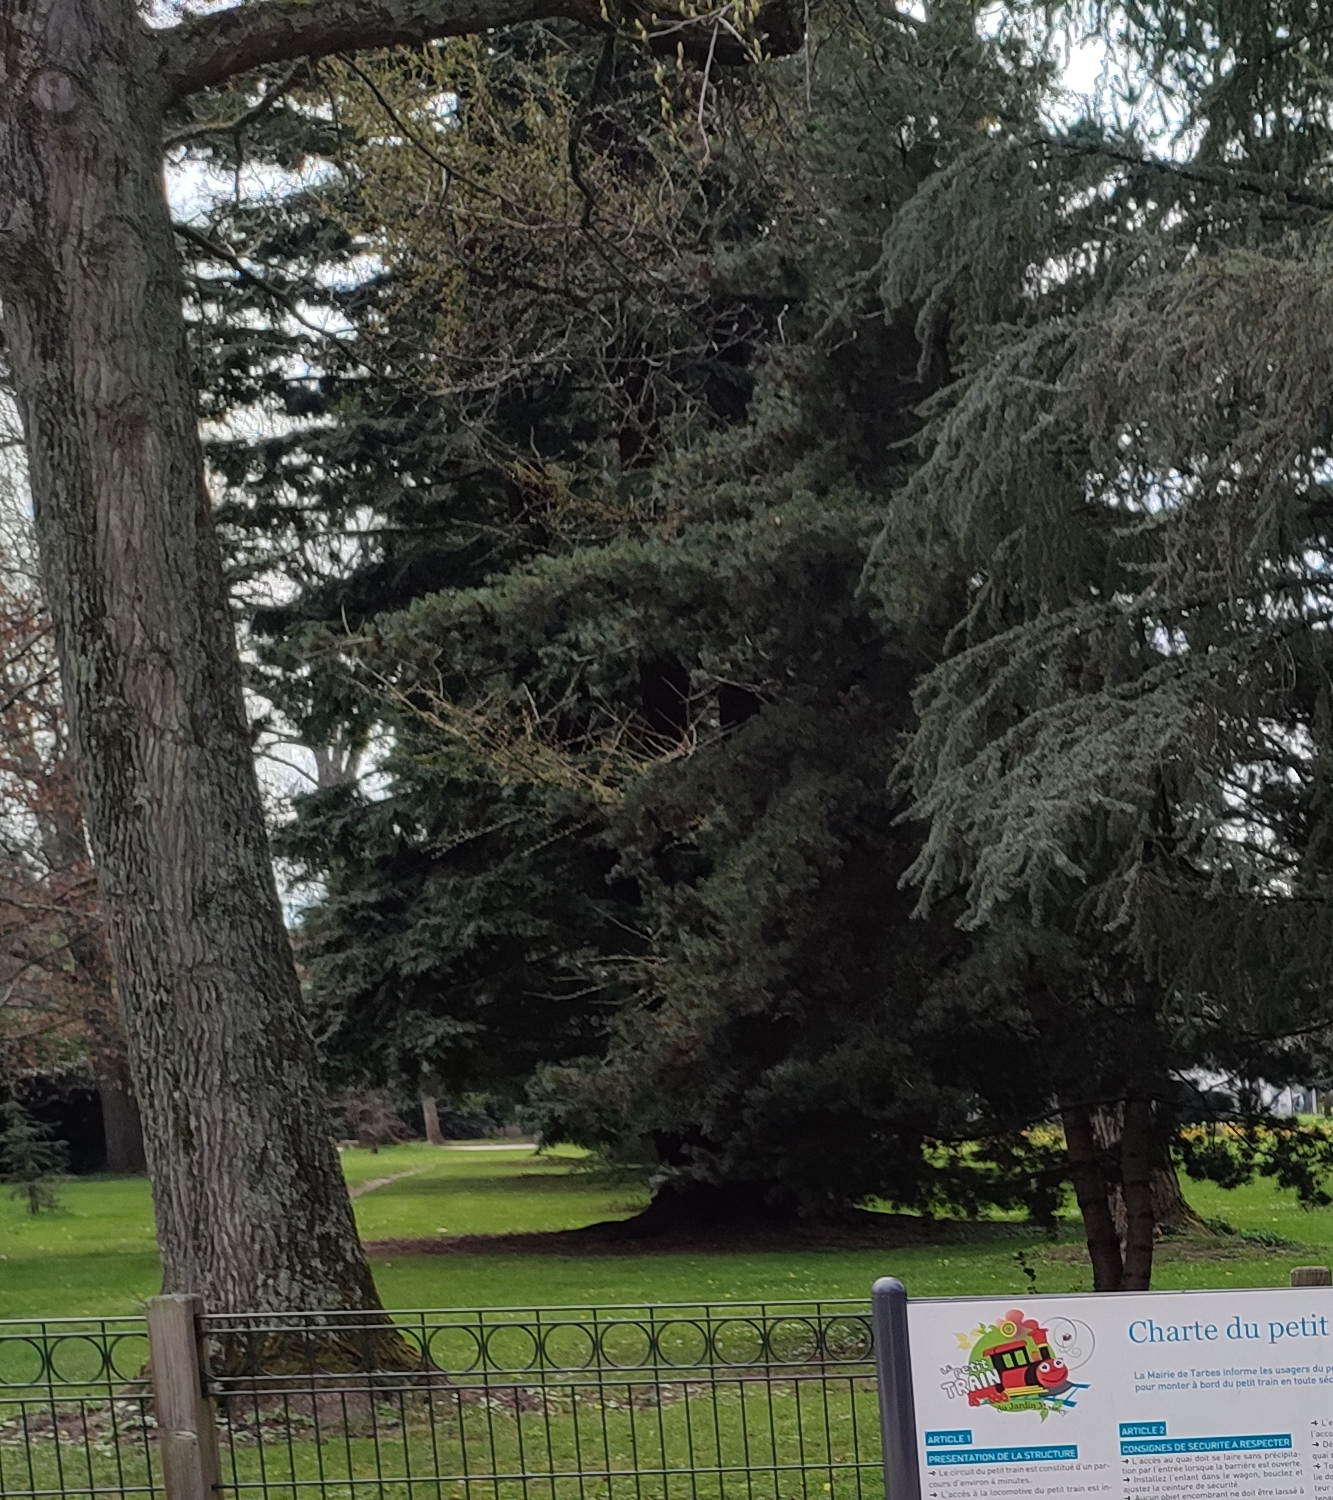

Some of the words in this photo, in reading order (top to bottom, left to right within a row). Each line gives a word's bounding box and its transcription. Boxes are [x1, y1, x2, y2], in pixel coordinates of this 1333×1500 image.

[1128, 1318, 1218, 1343] Charte
[1226, 1316, 1260, 1340] du
[1268, 1313, 1330, 1344] petit
[954, 1359, 989, 1380] petit
[1134, 1369, 1145, 1380] La
[1147, 1368, 1175, 1379] Mairie
[1177, 1368, 1188, 1378] de
[1189, 1366, 1221, 1378] Tarbes
[1222, 1365, 1258, 1376] informe
[1259, 1364, 1273, 1375] les
[1274, 1365, 1311, 1377] usagers
[1312, 1362, 1324, 1373] du
[941, 1369, 1001, 1399] TRAIN
[1135, 1383, 1156, 1394] pour
[1157, 1379, 1190, 1390] monter
[1191, 1379, 1198, 1389] à
[1199, 1378, 1220, 1389] bord
[1221, 1377, 1234, 1388] du
[1235, 1376, 1255, 1390] petit
[1257, 1375, 1279, 1386] train
[1280, 1377, 1292, 1385] en
[1293, 1374, 1316, 1385] toute
[1009, 1402, 1036, 1411] Jardin
[928, 1434, 964, 1443] ARTICLE
[965, 1434, 971, 1442] 1
[1121, 1426, 1158, 1435] ARTICLE
[1159, 1426, 1165, 1434] 2
[1122, 1443, 1172, 1453] CONSIGNES
[1173, 1443, 1186, 1451] DE
[1187, 1441, 1230, 1451] SECURITE
[1231, 1441, 1238, 1449] A
[1239, 1438, 1290, 1449] RESPECTER
[928, 1453, 995, 1463] PRESENTATION
[996, 1452, 1009, 1460] DE
[1010, 1451, 1022, 1460] LA
[1023, 1449, 1076, 1459] STRUCTURE
